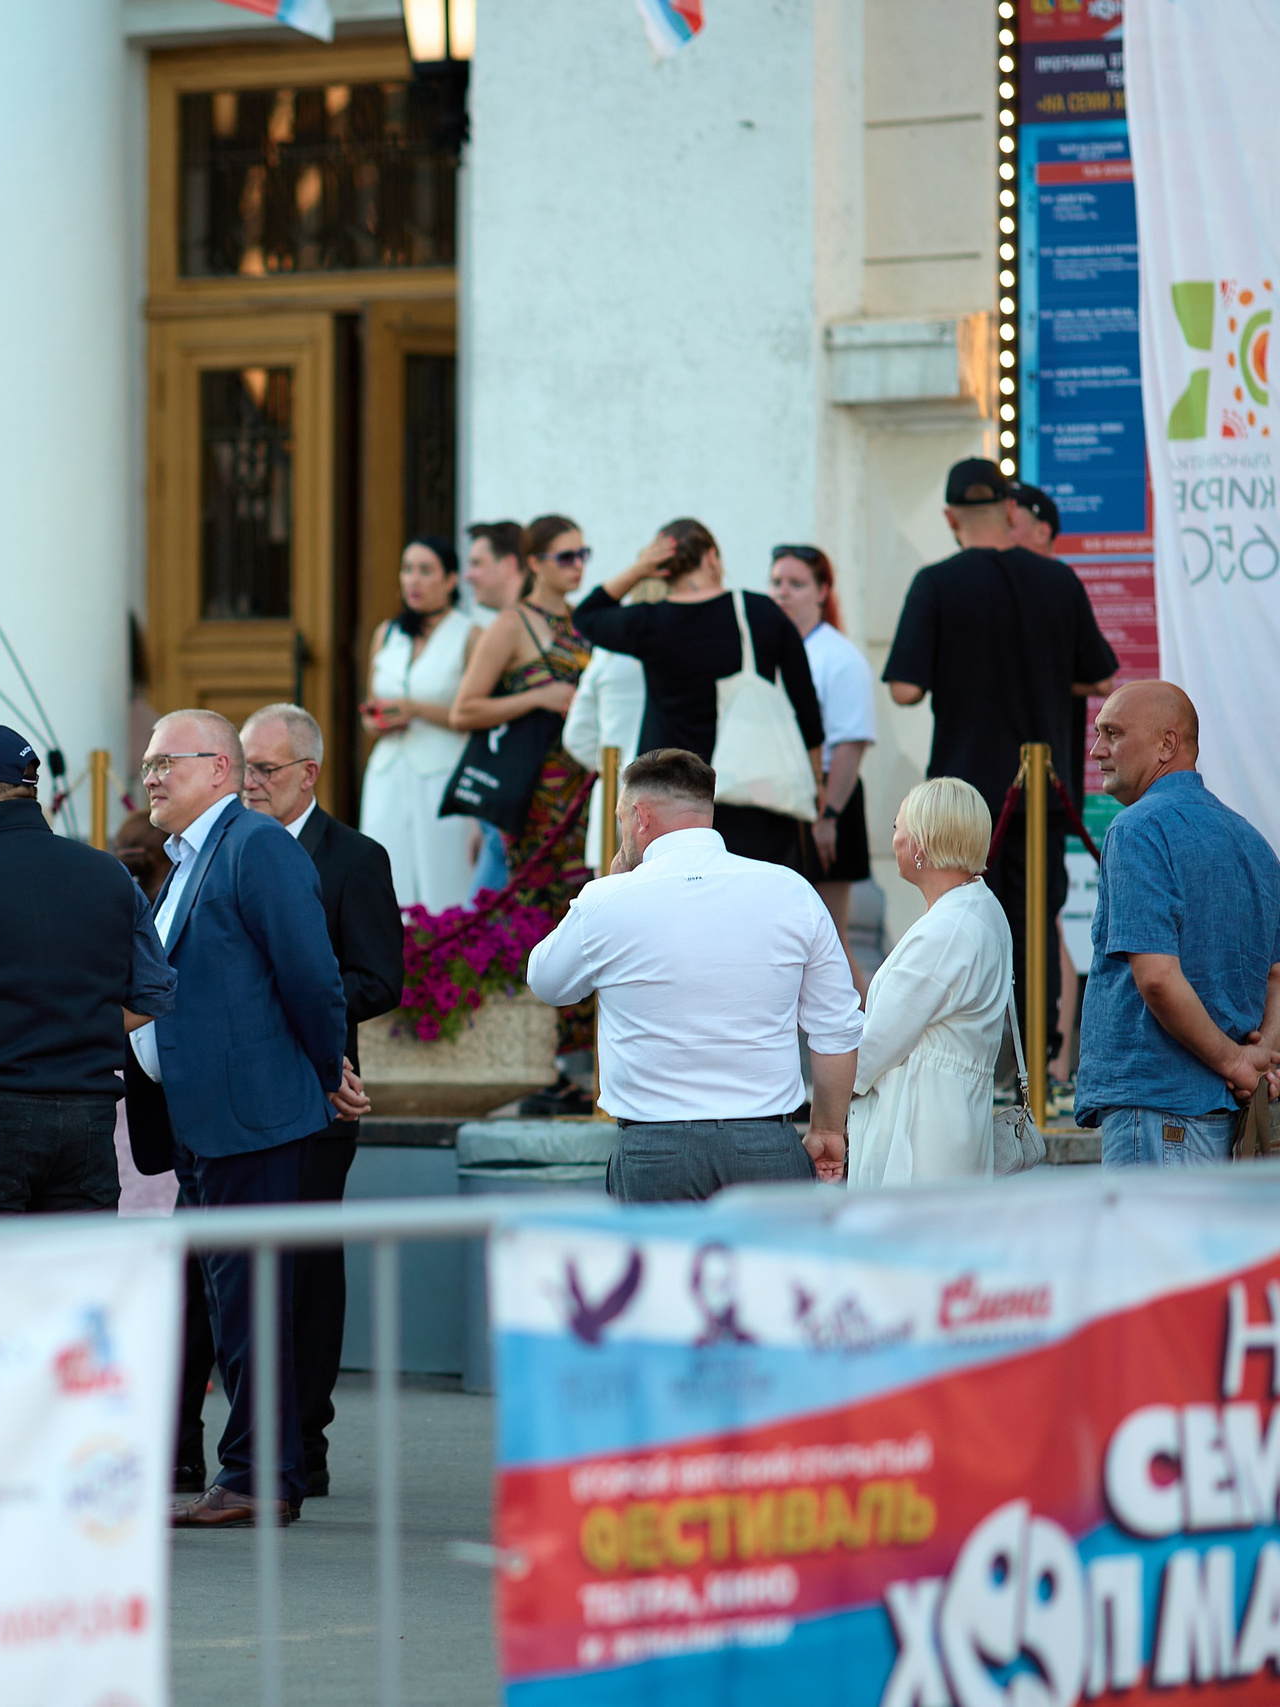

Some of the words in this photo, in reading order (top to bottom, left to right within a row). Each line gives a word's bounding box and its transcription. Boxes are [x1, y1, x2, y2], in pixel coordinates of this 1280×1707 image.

[1223, 1280, 1280, 1398] Н
[580, 1478, 937, 1571] ФЕСТИВАЛЬ
[1106, 1402, 1280, 1537] СЕМ
